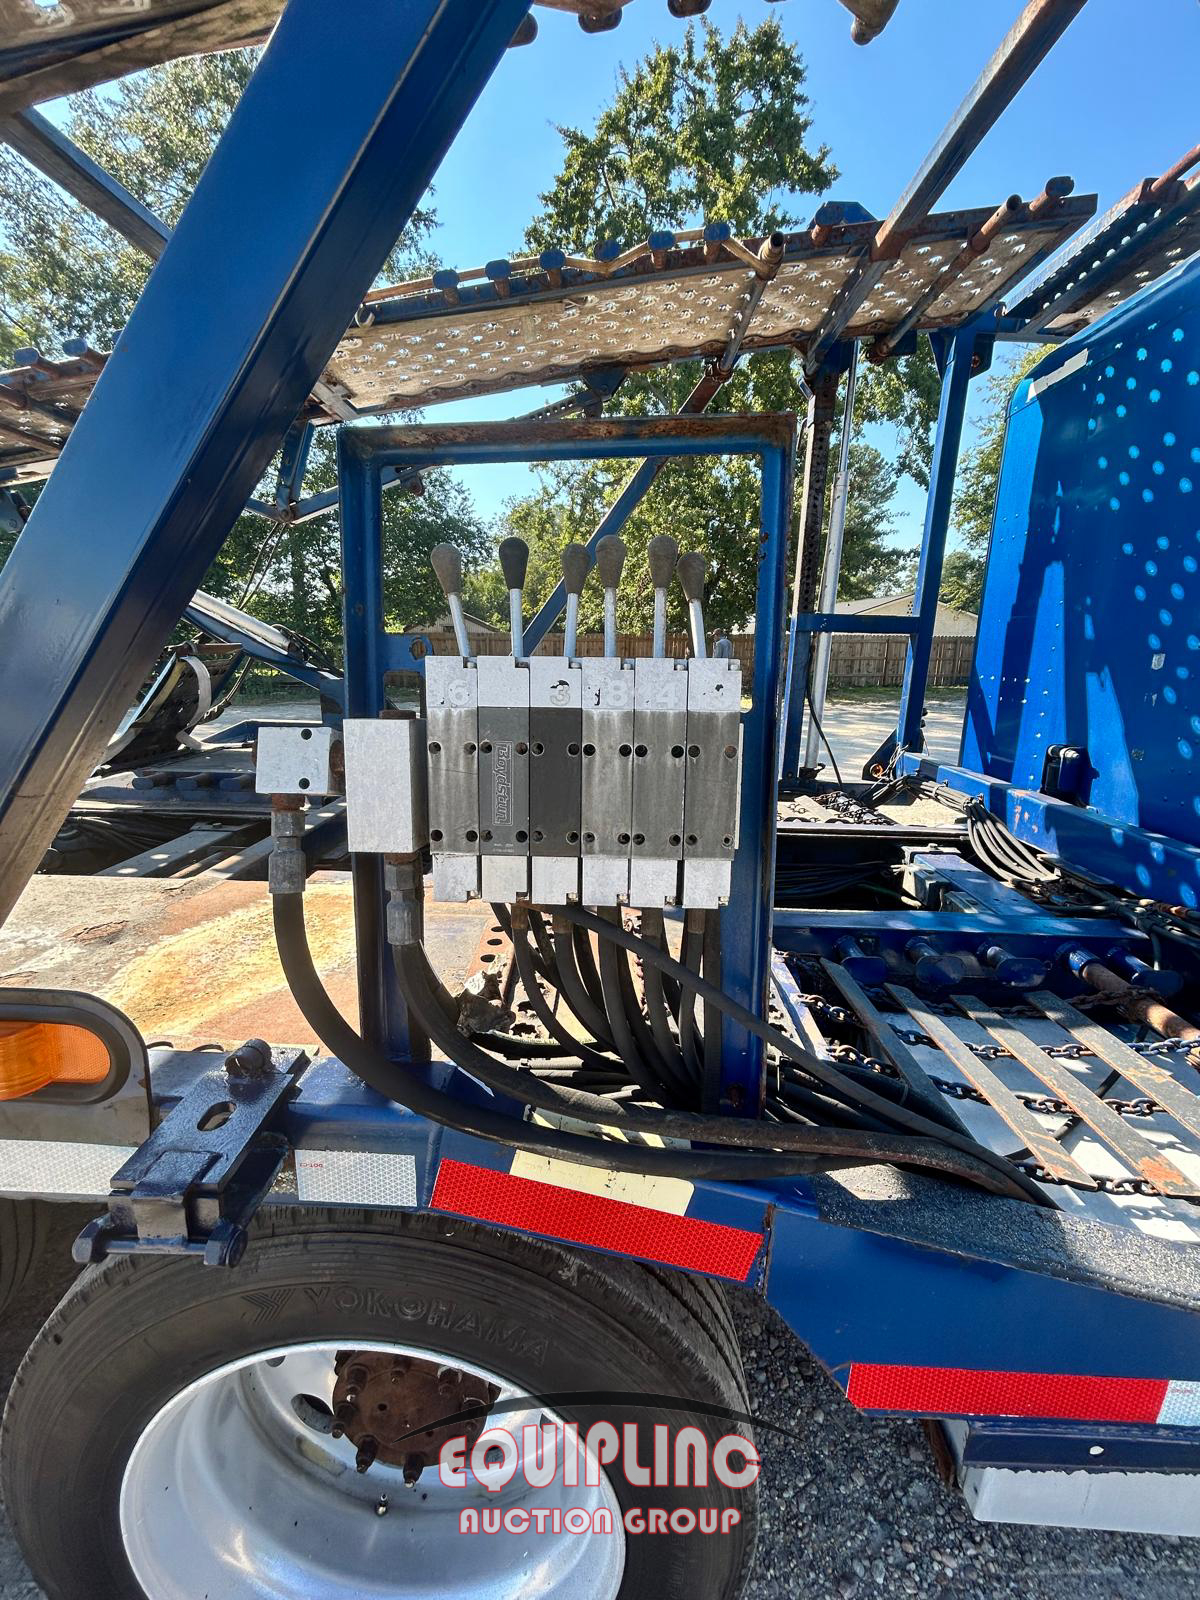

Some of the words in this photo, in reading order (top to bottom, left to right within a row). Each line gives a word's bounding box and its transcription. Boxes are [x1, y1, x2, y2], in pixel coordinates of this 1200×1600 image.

[550, 679, 571, 706] 3
[493, 742, 512, 824] Boydstun
[302, 1285, 551, 1367] YOKOHAMA
